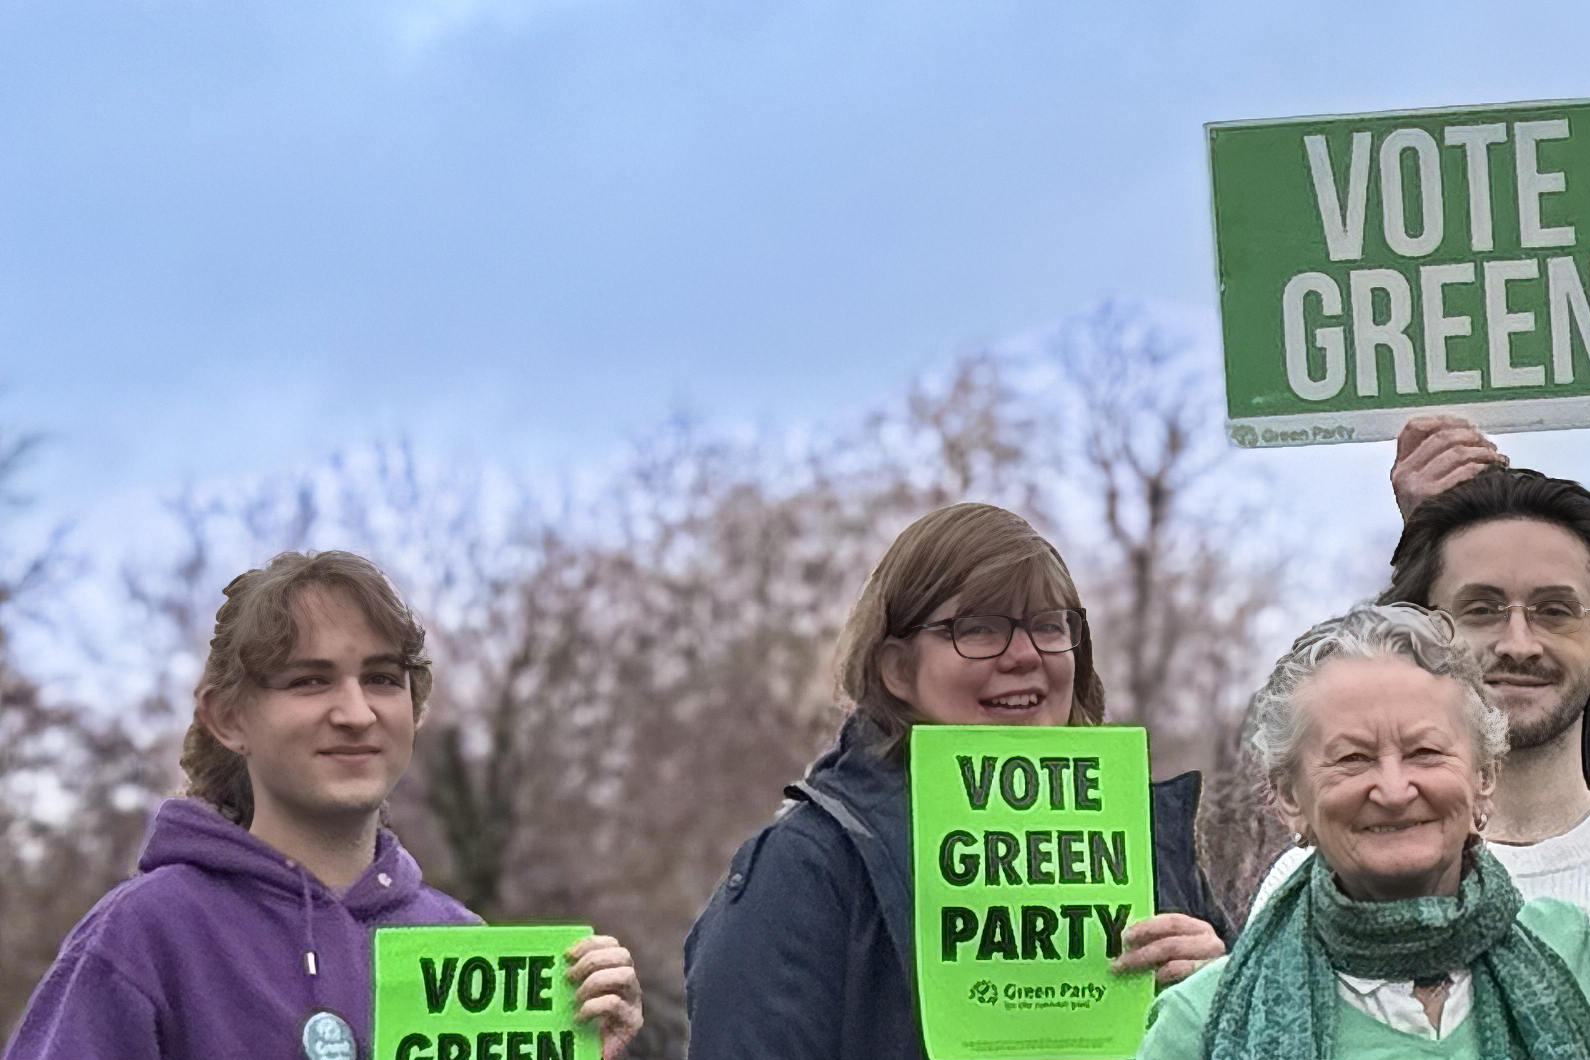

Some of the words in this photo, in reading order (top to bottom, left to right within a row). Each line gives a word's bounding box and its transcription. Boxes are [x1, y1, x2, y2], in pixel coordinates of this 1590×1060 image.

[1304, 118, 1576, 261] VOTE
[956, 755, 1102, 811] VOTE
[939, 830, 1129, 886] GREEN
[941, 904, 1132, 962] PARTY
[419, 955, 555, 1014] VOTE
[1004, 983, 1056, 1000] Green
[1060, 982, 1106, 1002] Party
